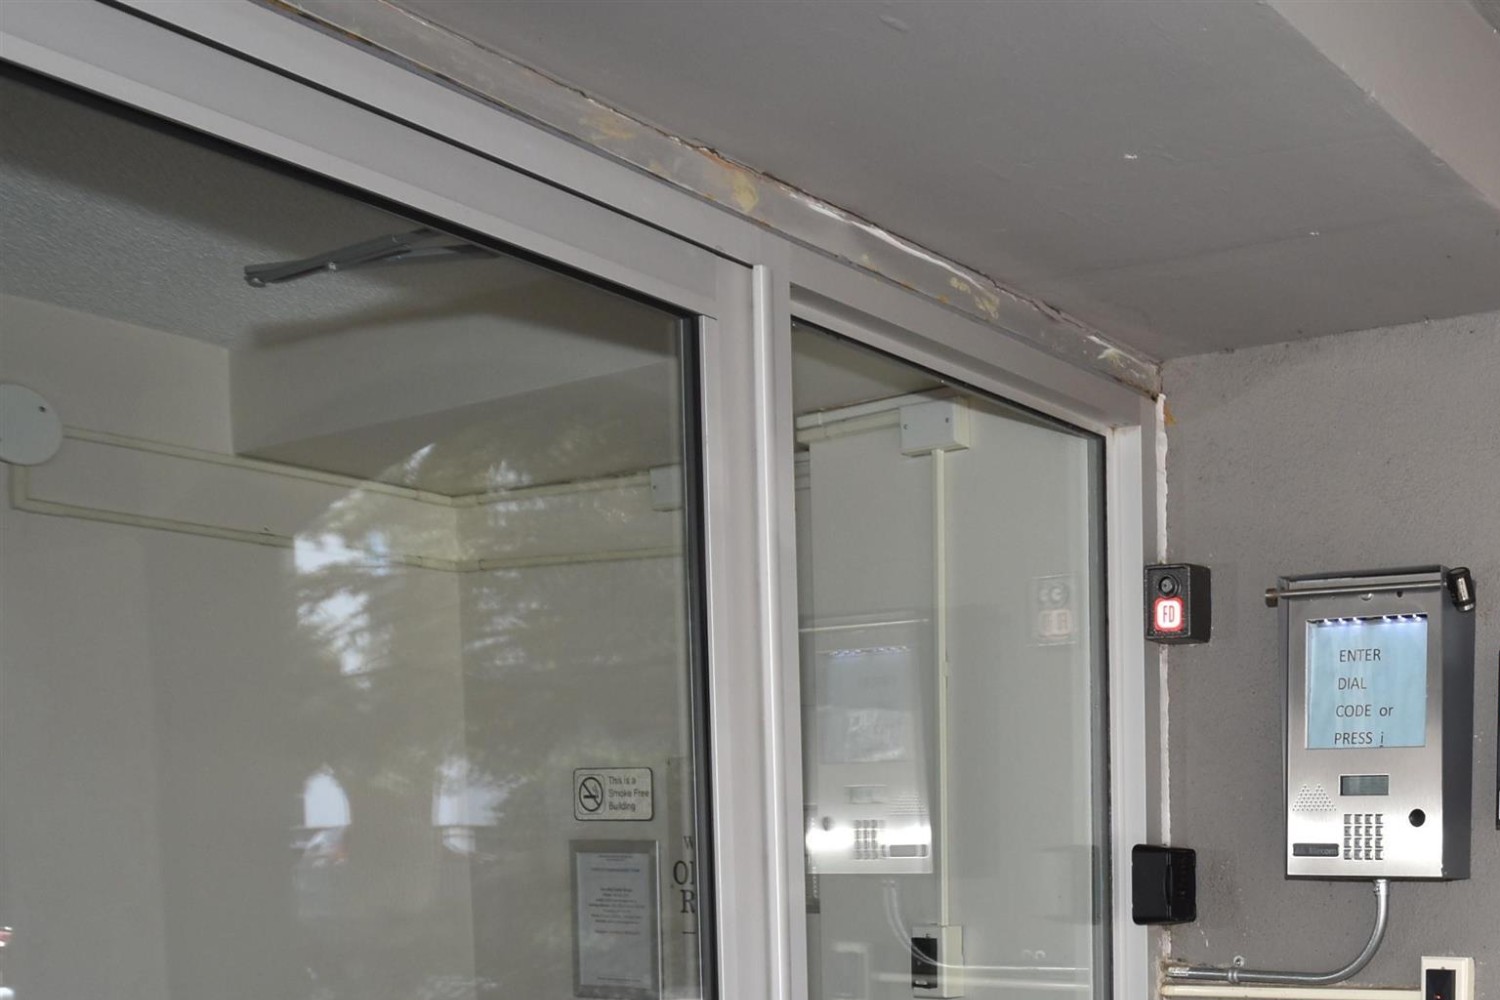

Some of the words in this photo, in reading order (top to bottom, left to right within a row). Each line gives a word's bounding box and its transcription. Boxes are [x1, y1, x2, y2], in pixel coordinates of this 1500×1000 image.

[1162, 605, 1175, 623] FD
[1339, 649, 1381, 663] ENTER
[1337, 677, 1367, 690] DIAL
[1335, 704, 1372, 718] CODE
[1379, 706, 1394, 717] or
[1334, 731, 1373, 745] PRESS
[608, 776, 622, 785] This
[608, 788, 632, 798] Smoke
[633, 788, 649, 798] Free
[608, 801, 636, 812] Building
